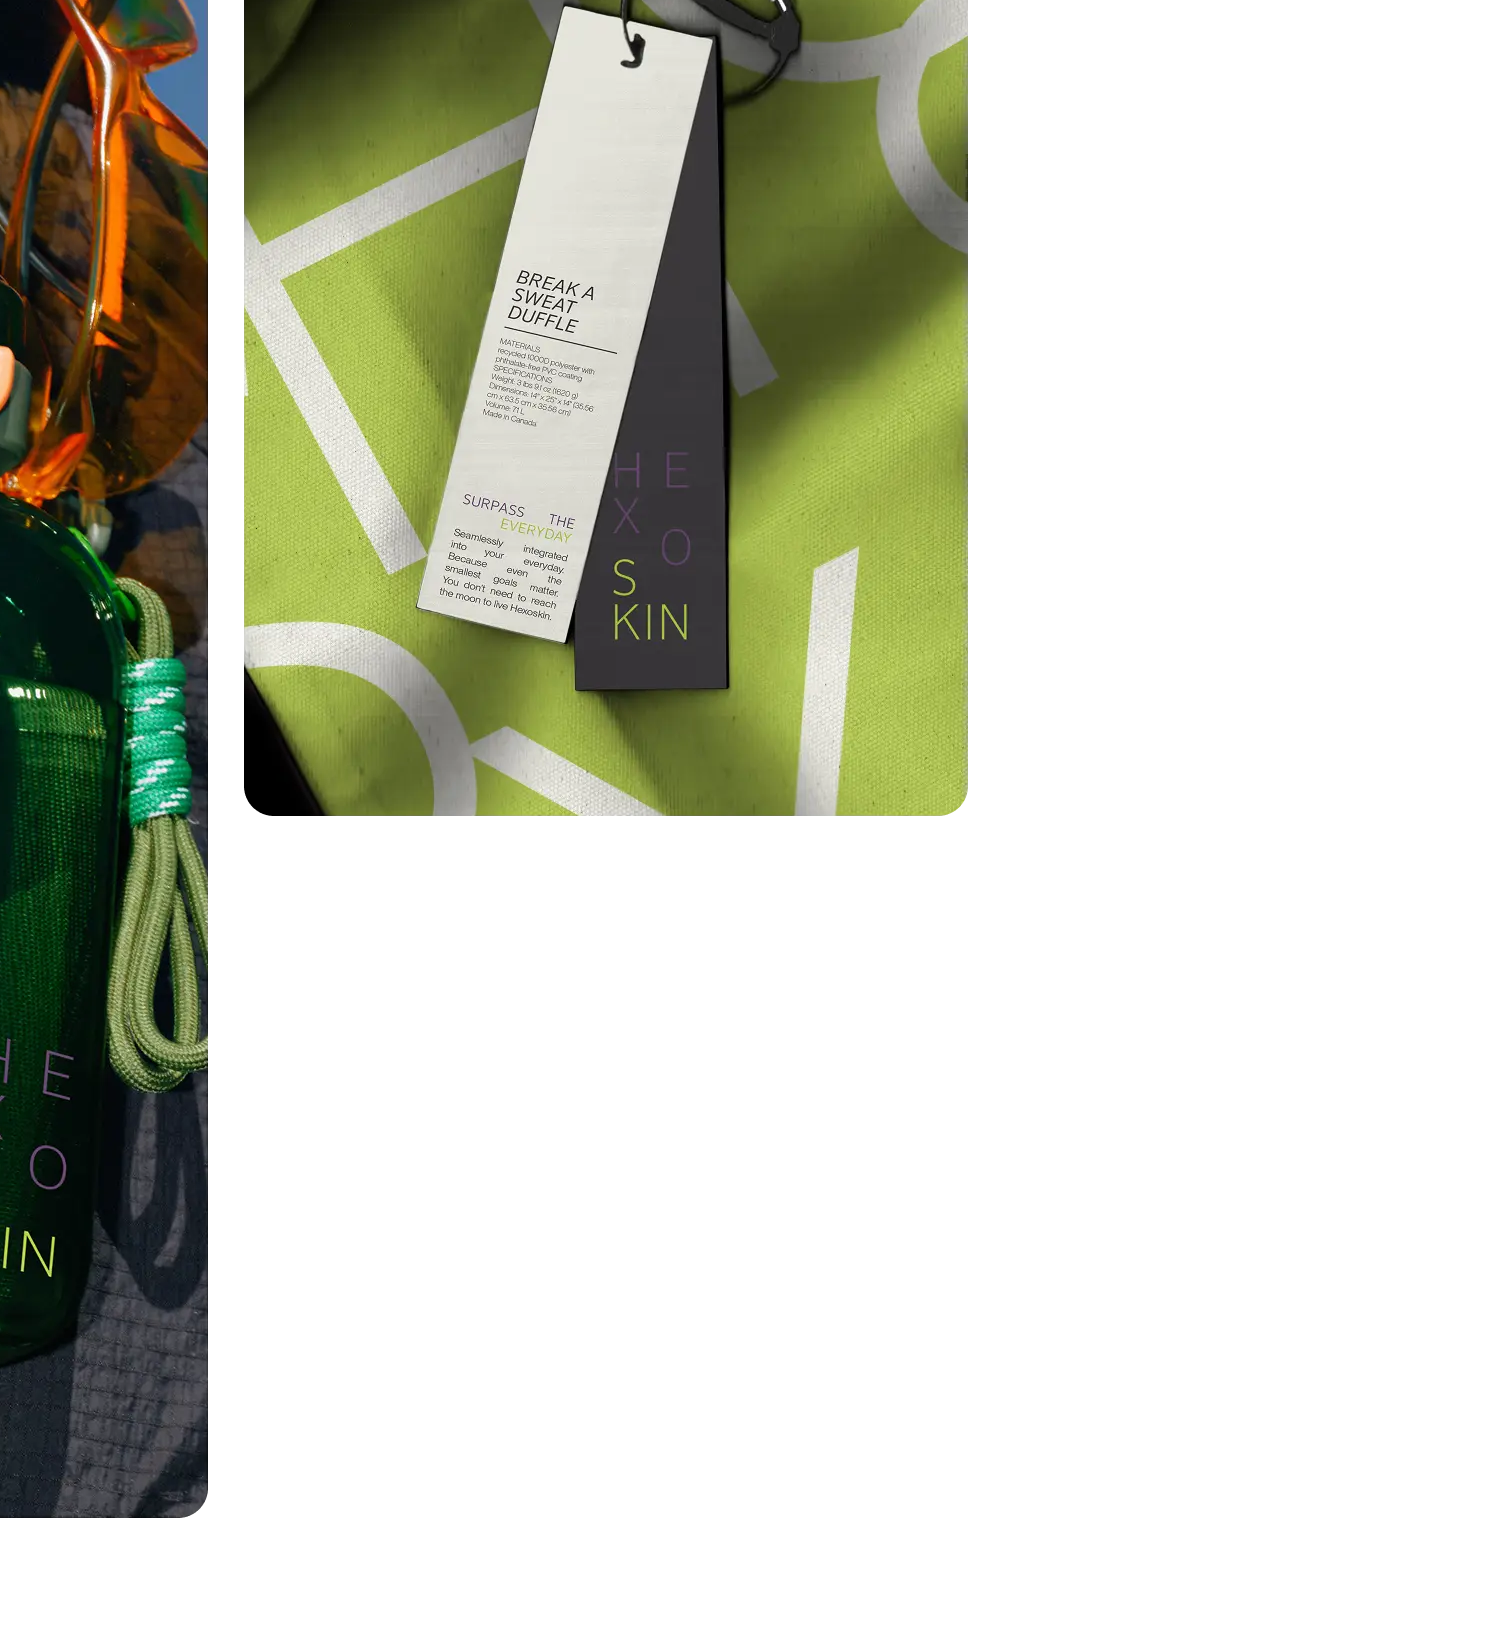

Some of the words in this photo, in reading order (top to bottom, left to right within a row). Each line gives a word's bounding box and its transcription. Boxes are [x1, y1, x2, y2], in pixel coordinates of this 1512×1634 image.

[512, 288, 578, 314] SWEAT
[516, 270, 580, 297] BREAK
[581, 286, 594, 300] A
[508, 306, 579, 333] DUFFLE
[498, 348, 526, 358] recycled
[550, 360, 580, 371] polyester
[582, 367, 595, 375] with
[500, 338, 540, 353] MATERIALS
[492, 373, 515, 384] Weight:
[493, 365, 552, 384] SPECIFICATIONS
[542, 367, 557, 375] PVC
[558, 371, 582, 383] coating
[505, 395, 519, 404] 63.5
[483, 409, 502, 418] Made
[511, 415, 537, 427] Canada
[463, 494, 525, 517] SURPASS
[549, 514, 575, 529] THE
[614, 498, 639, 534] X
[454, 528, 504, 548] Seamlessly
[523, 545, 568, 562] integrated
[500, 518, 572, 543] EVERYDAY
[451, 540, 467, 550] into
[484, 549, 504, 559] your
[524, 558, 564, 574] everyday.
[662, 529, 690, 565] O
[445, 565, 481, 579] smallest
[493, 576, 518, 587] goals
[529, 585, 559, 597] matter.
[448, 552, 487, 567] Because
[507, 567, 528, 577] even
[548, 575, 562, 585] the
[613, 559, 636, 596] S
[440, 588, 454, 597] the
[456, 592, 481, 604] moon
[483, 598, 492, 606] to
[494, 600, 508, 610] live
[510, 604, 552, 621] Hexoskin.
[443, 576, 459, 587] You
[464, 581, 485, 592] don't
[490, 588, 514, 599] need
[518, 593, 527, 602] to
[531, 598, 557, 609] reach
[614, 604, 687, 640] KIN
[30, 1145, 66, 1190] O
